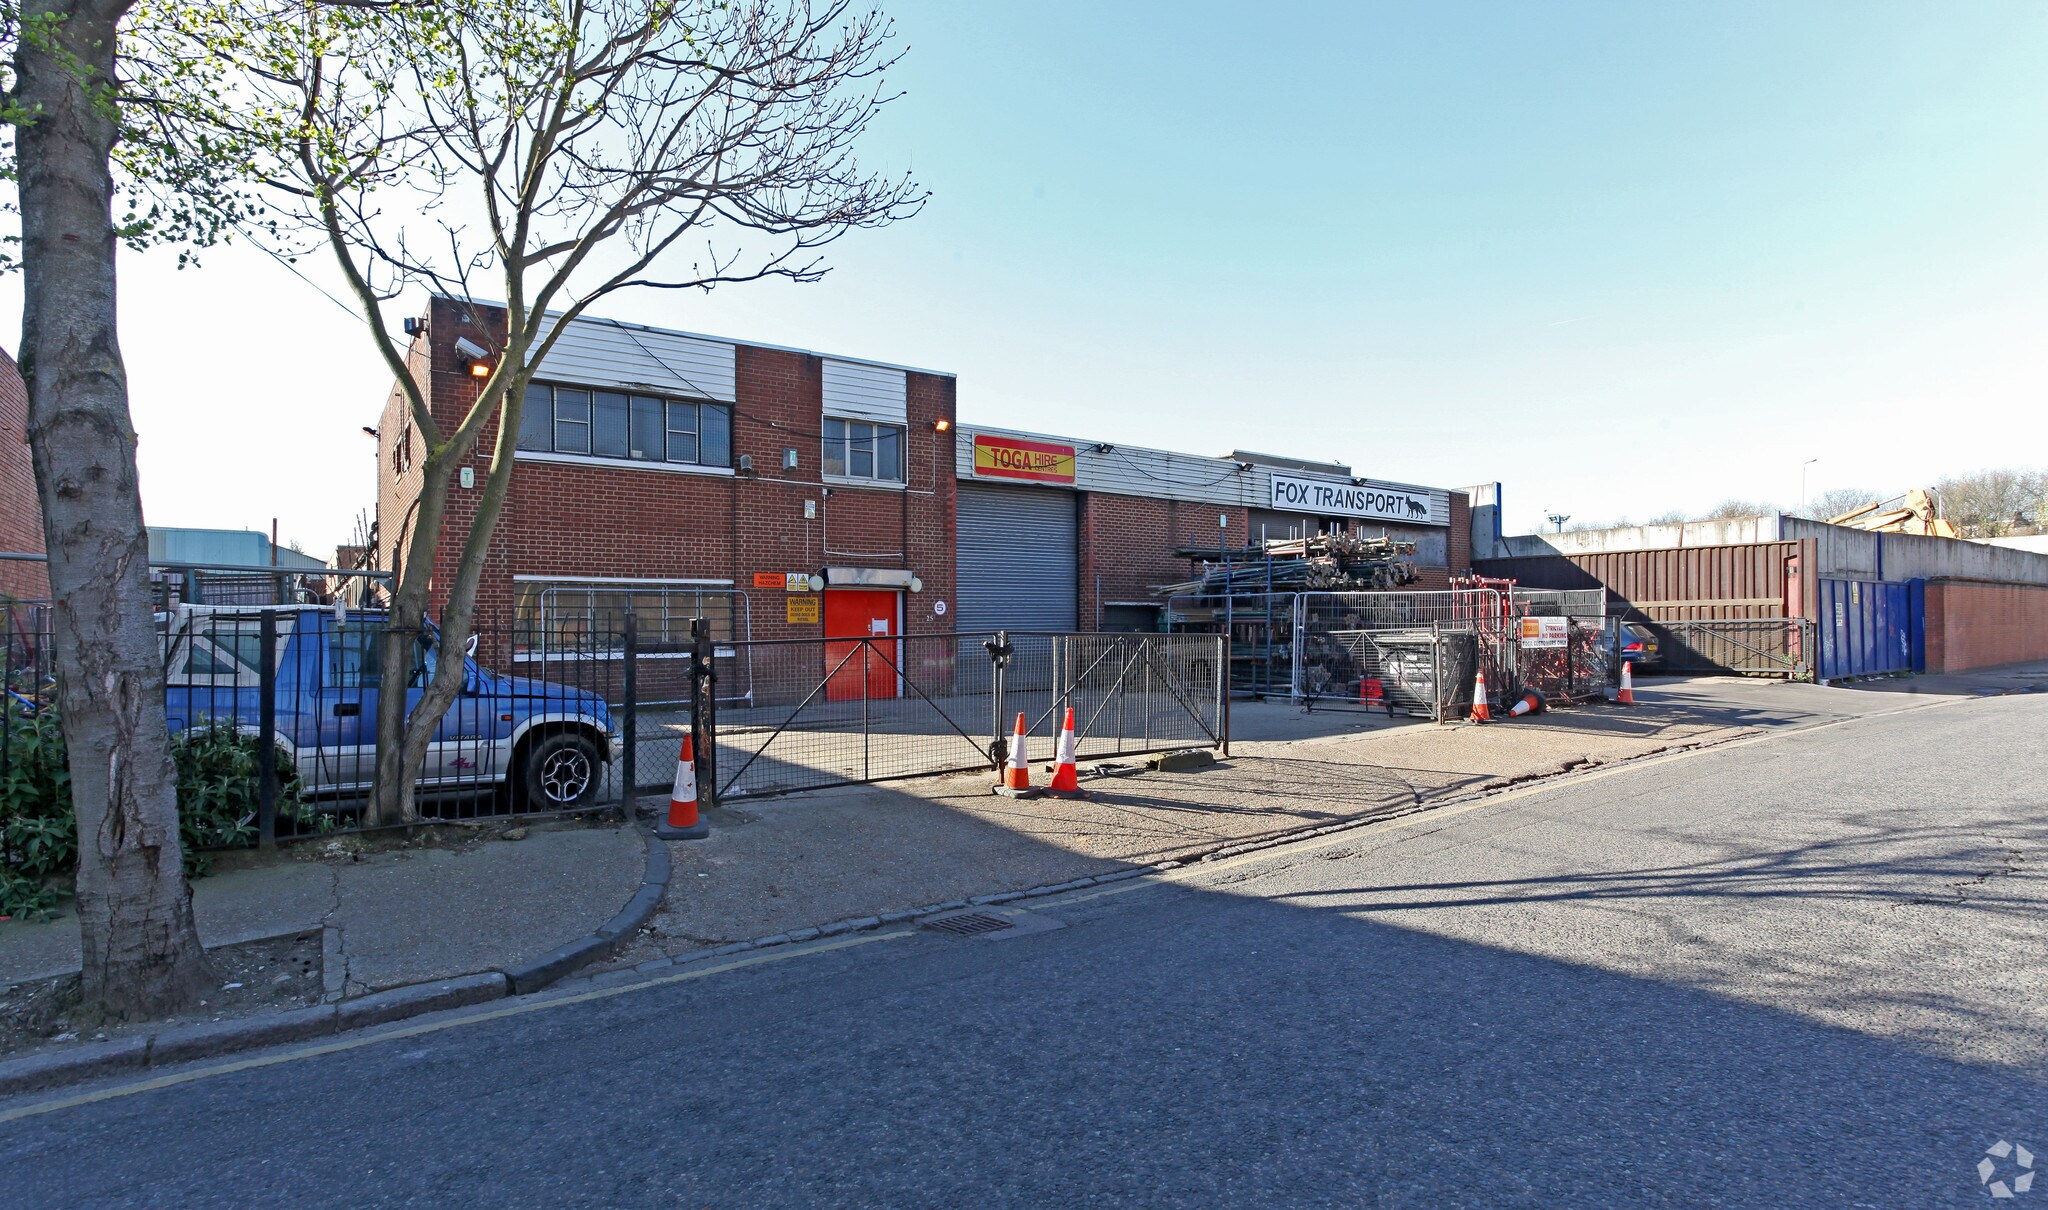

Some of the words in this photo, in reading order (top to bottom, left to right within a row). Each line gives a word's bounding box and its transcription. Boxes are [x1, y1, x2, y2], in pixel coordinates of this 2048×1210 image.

[990, 448, 1032, 470] TOGA
[1034, 453, 1057, 466] HIRE
[1275, 481, 1309, 504] FOX
[1313, 486, 1404, 514] TRANSPORT
[789, 598, 816, 606] WARNING
[936, 604, 944, 612] 5
